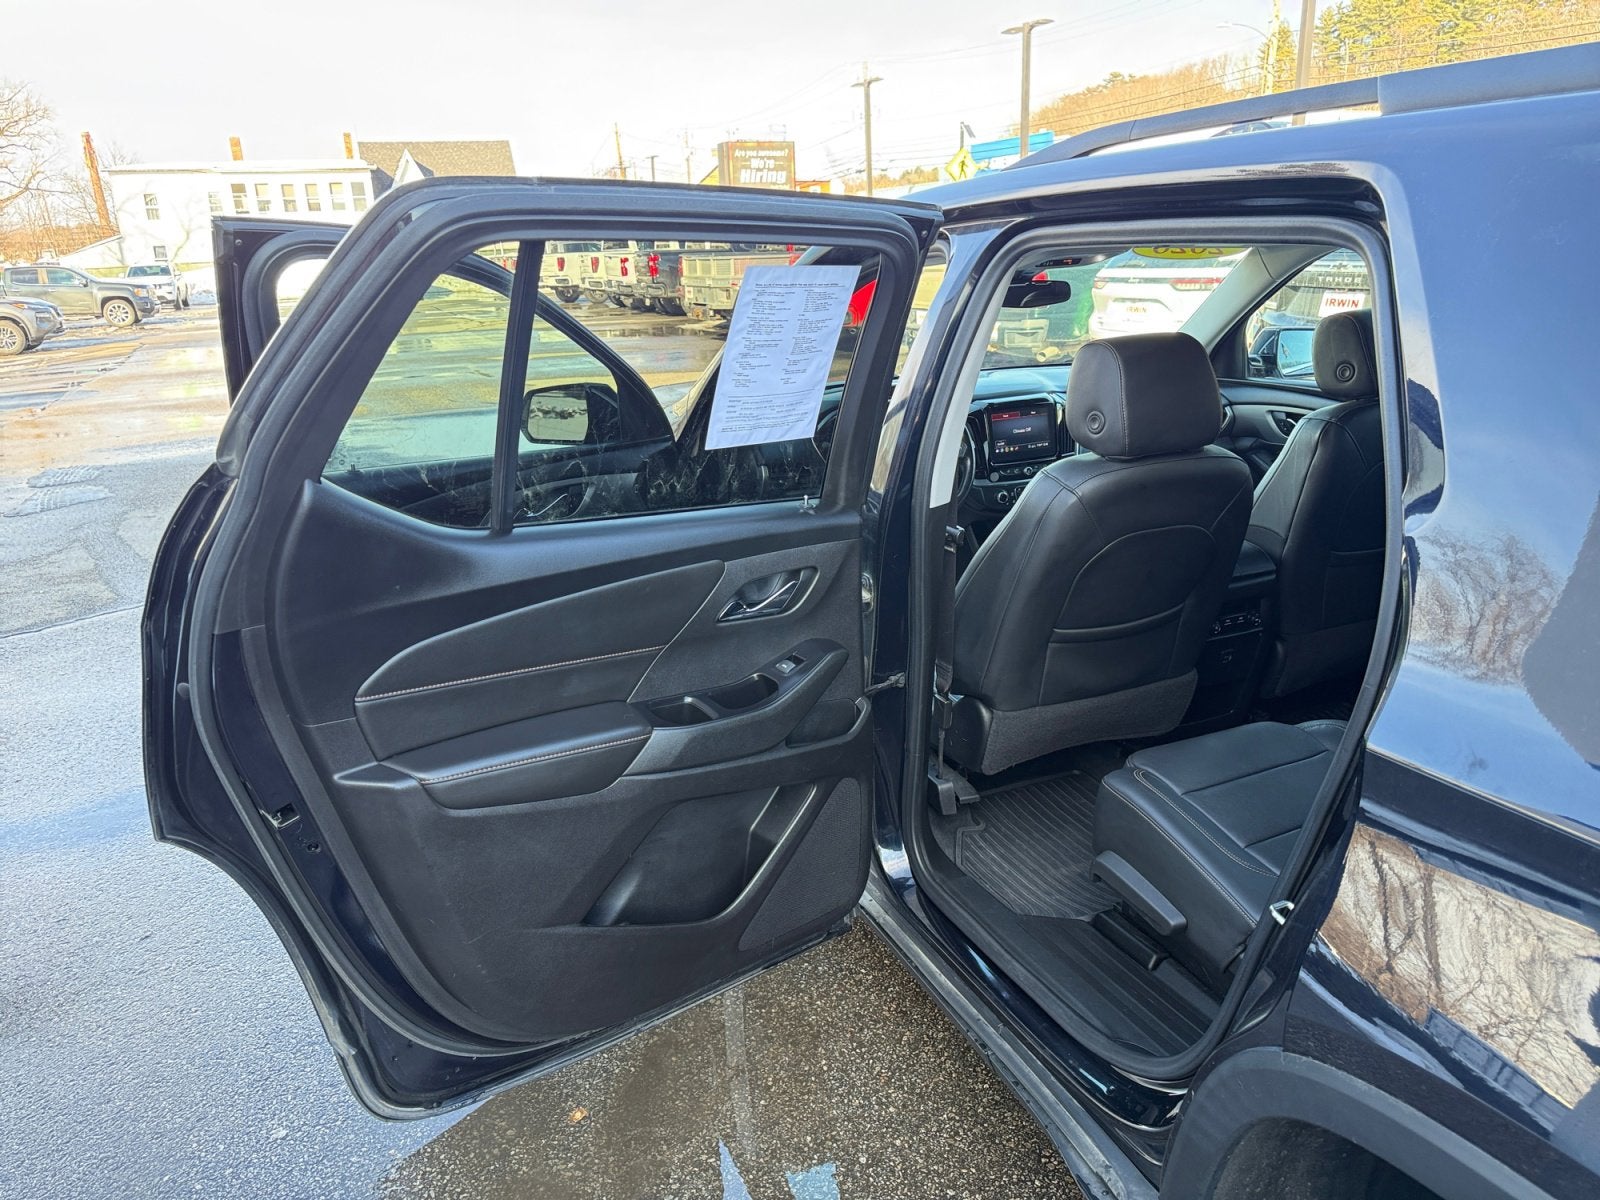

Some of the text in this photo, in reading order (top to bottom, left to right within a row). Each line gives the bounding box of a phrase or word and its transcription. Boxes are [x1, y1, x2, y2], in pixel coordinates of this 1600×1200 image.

[735, 149, 745, 157] Are
[746, 150, 757, 158] you
[750, 158, 774, 168] We're
[740, 169, 786, 184] Hiring
[1325, 298, 1359, 308] IRWIN
